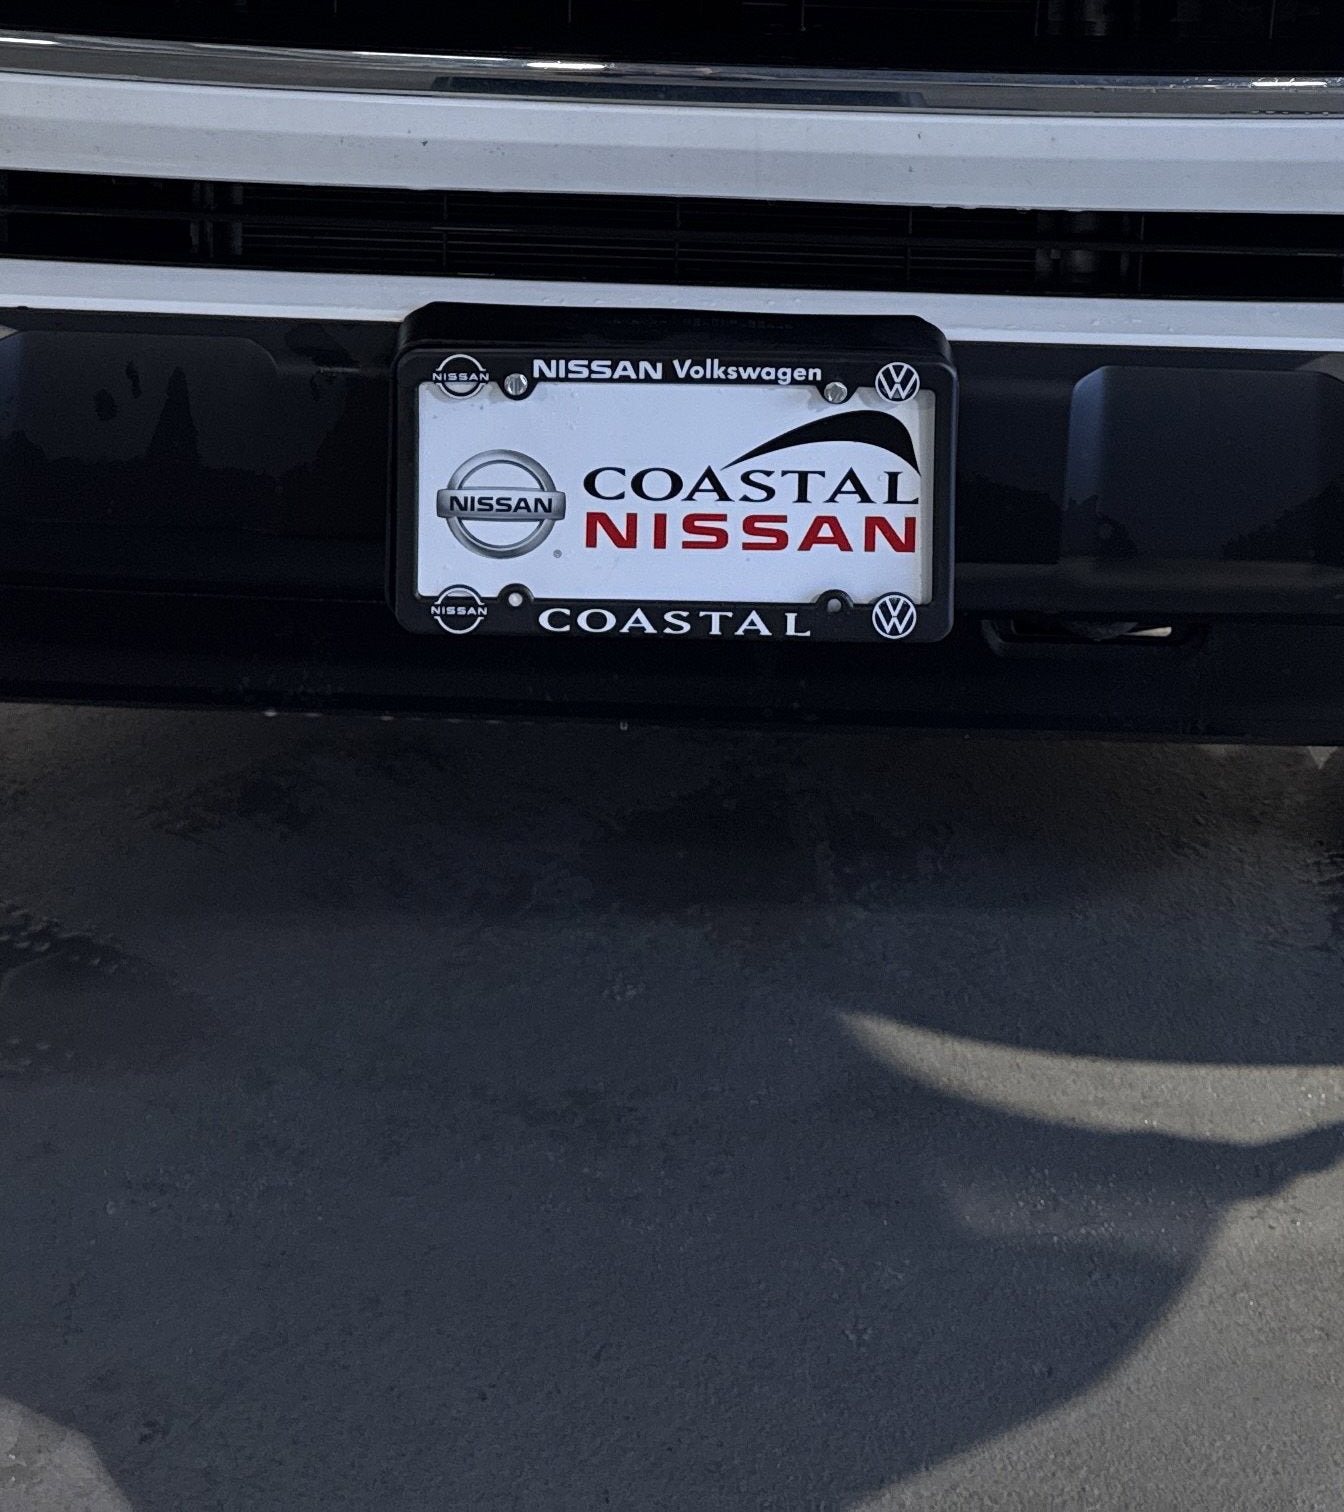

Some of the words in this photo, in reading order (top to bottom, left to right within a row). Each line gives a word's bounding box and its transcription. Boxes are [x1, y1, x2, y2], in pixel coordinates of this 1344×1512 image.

[432, 371, 490, 382] NISSAN
[532, 358, 663, 380] NISSAN
[672, 358, 822, 386] Volkswagen
[582, 465, 920, 505] COASTAL
[449, 495, 553, 514] NISSAN
[585, 511, 917, 553] NISSAN
[430, 604, 488, 617] NISSAN
[538, 607, 812, 638] COASTAL
